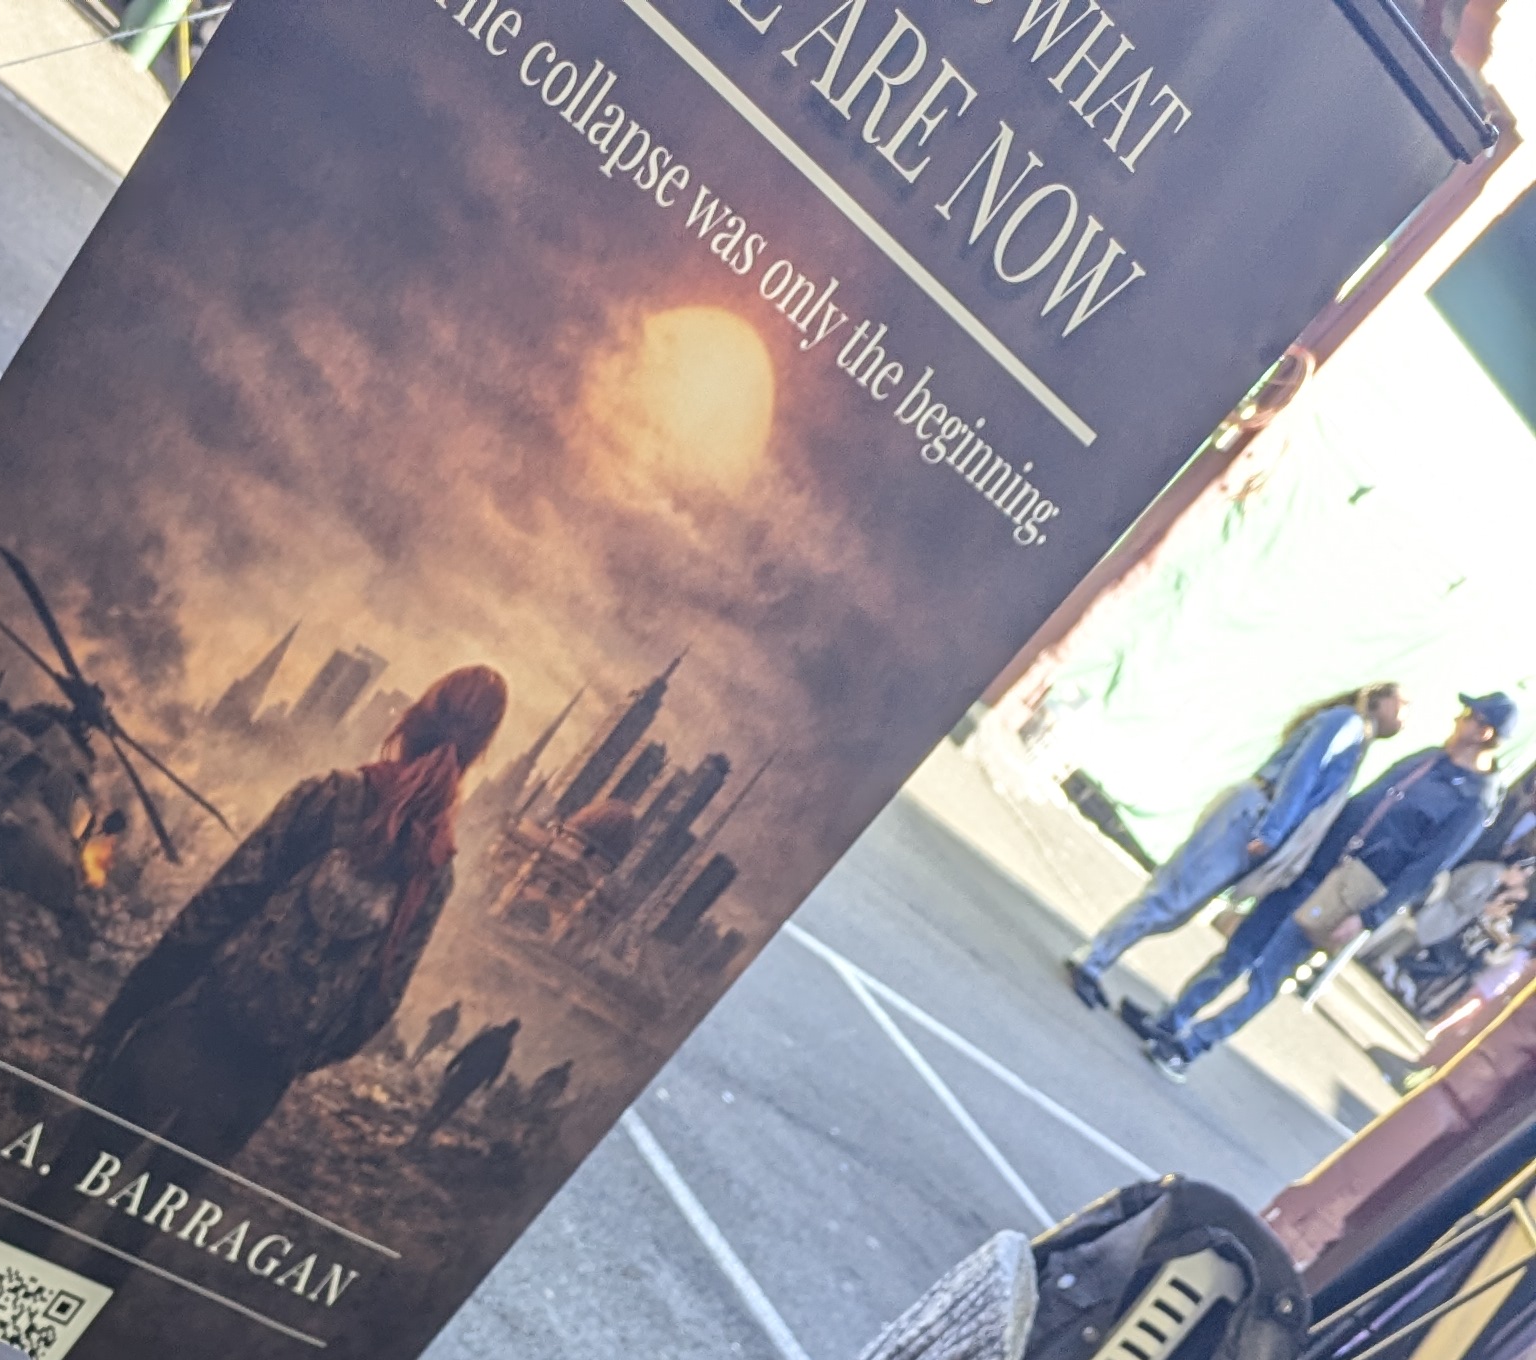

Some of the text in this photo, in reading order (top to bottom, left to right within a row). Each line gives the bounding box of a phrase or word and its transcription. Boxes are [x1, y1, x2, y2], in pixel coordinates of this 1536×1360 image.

[780, 0, 1146, 336] ARE NOW
[1013, 0, 1192, 173] WHAT
[520, 57, 1059, 545] collapse was only the beginning.
[1, 1122, 51, 1175] A.
[75, 1151, 359, 1307] BARRAGAN
